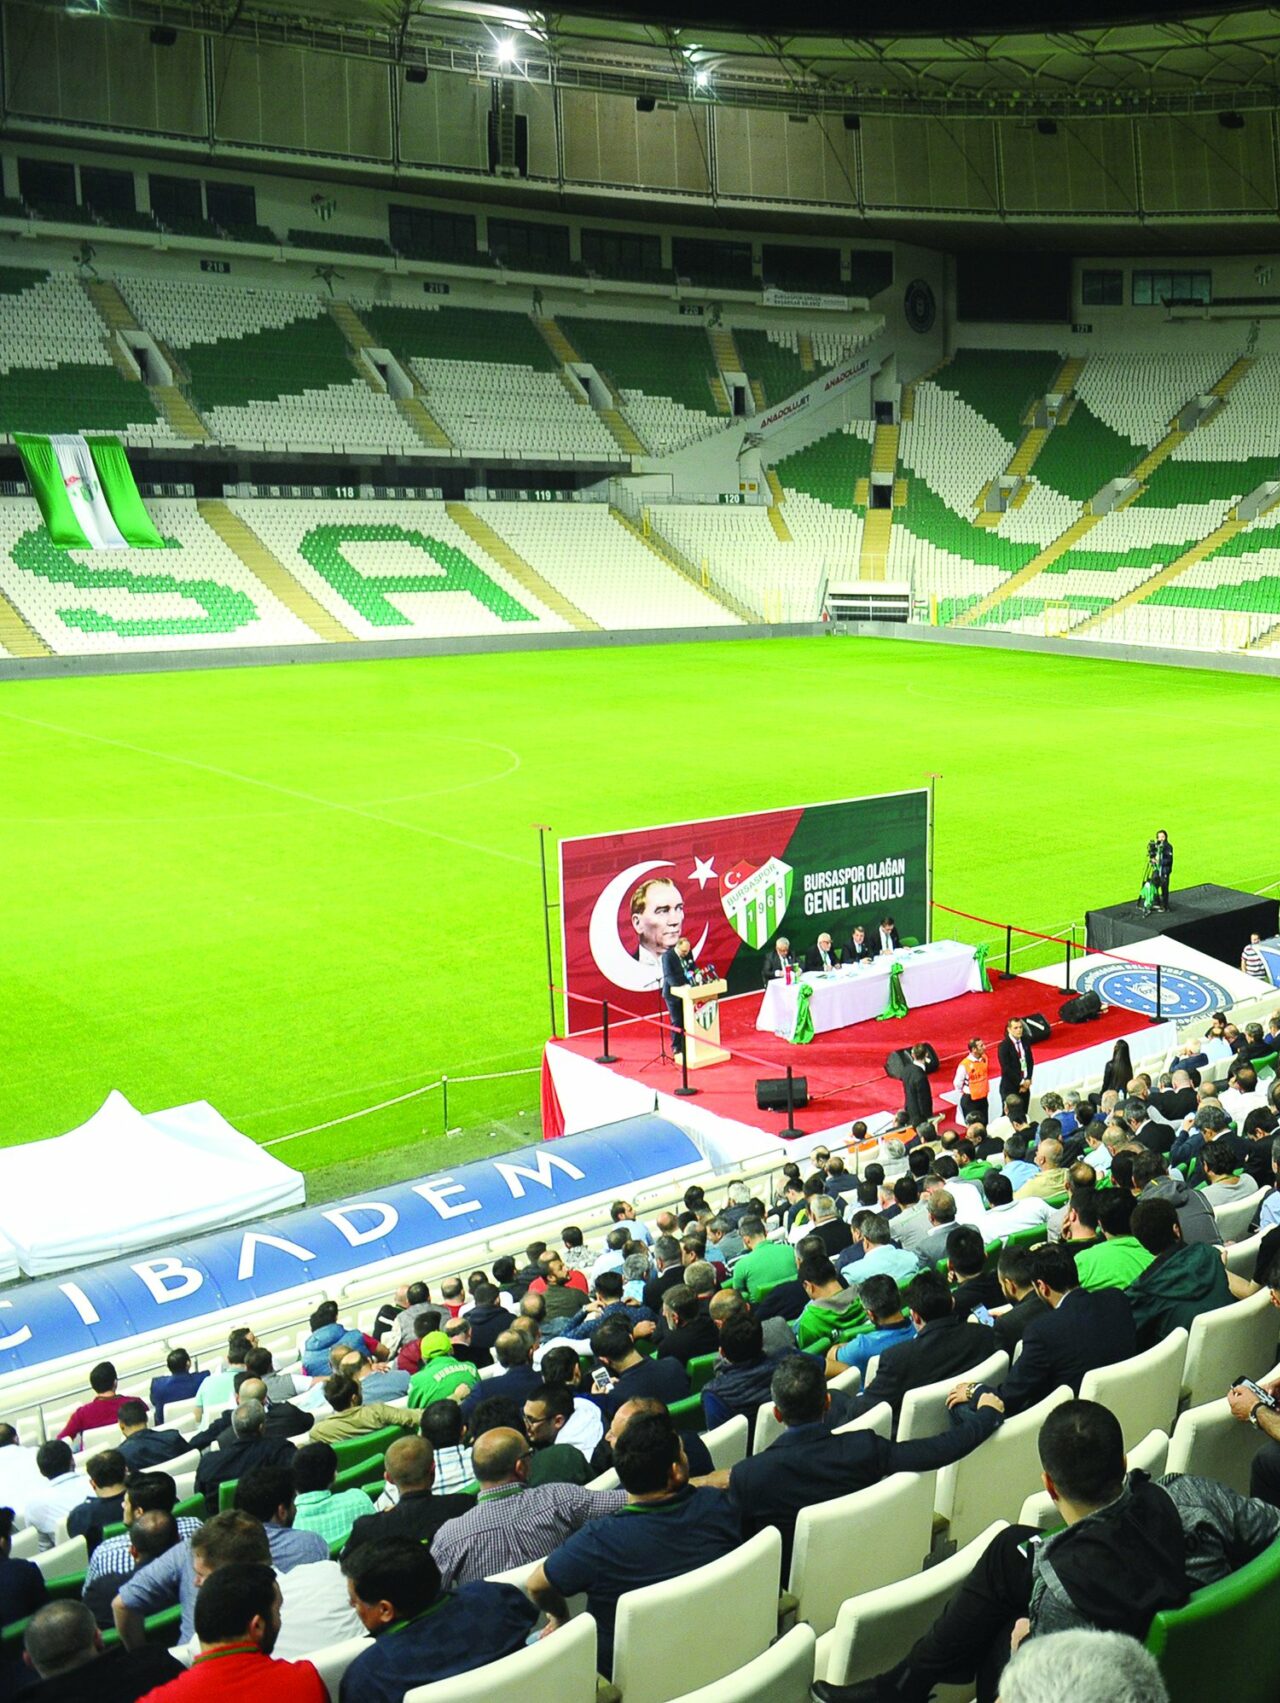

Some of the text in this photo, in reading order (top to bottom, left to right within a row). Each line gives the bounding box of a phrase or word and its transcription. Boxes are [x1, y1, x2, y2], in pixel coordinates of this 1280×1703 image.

[760, 394, 810, 429] ANADOLUJET
[335, 486, 354, 498] 118
[535, 490, 551, 501] 119
[725, 494, 740, 504] 120
[726, 863, 777, 906] BURSASPOR
[804, 857, 905, 892] BURSASPOR OLAĞAN
[804, 876, 905, 916] GENEL KURULU
